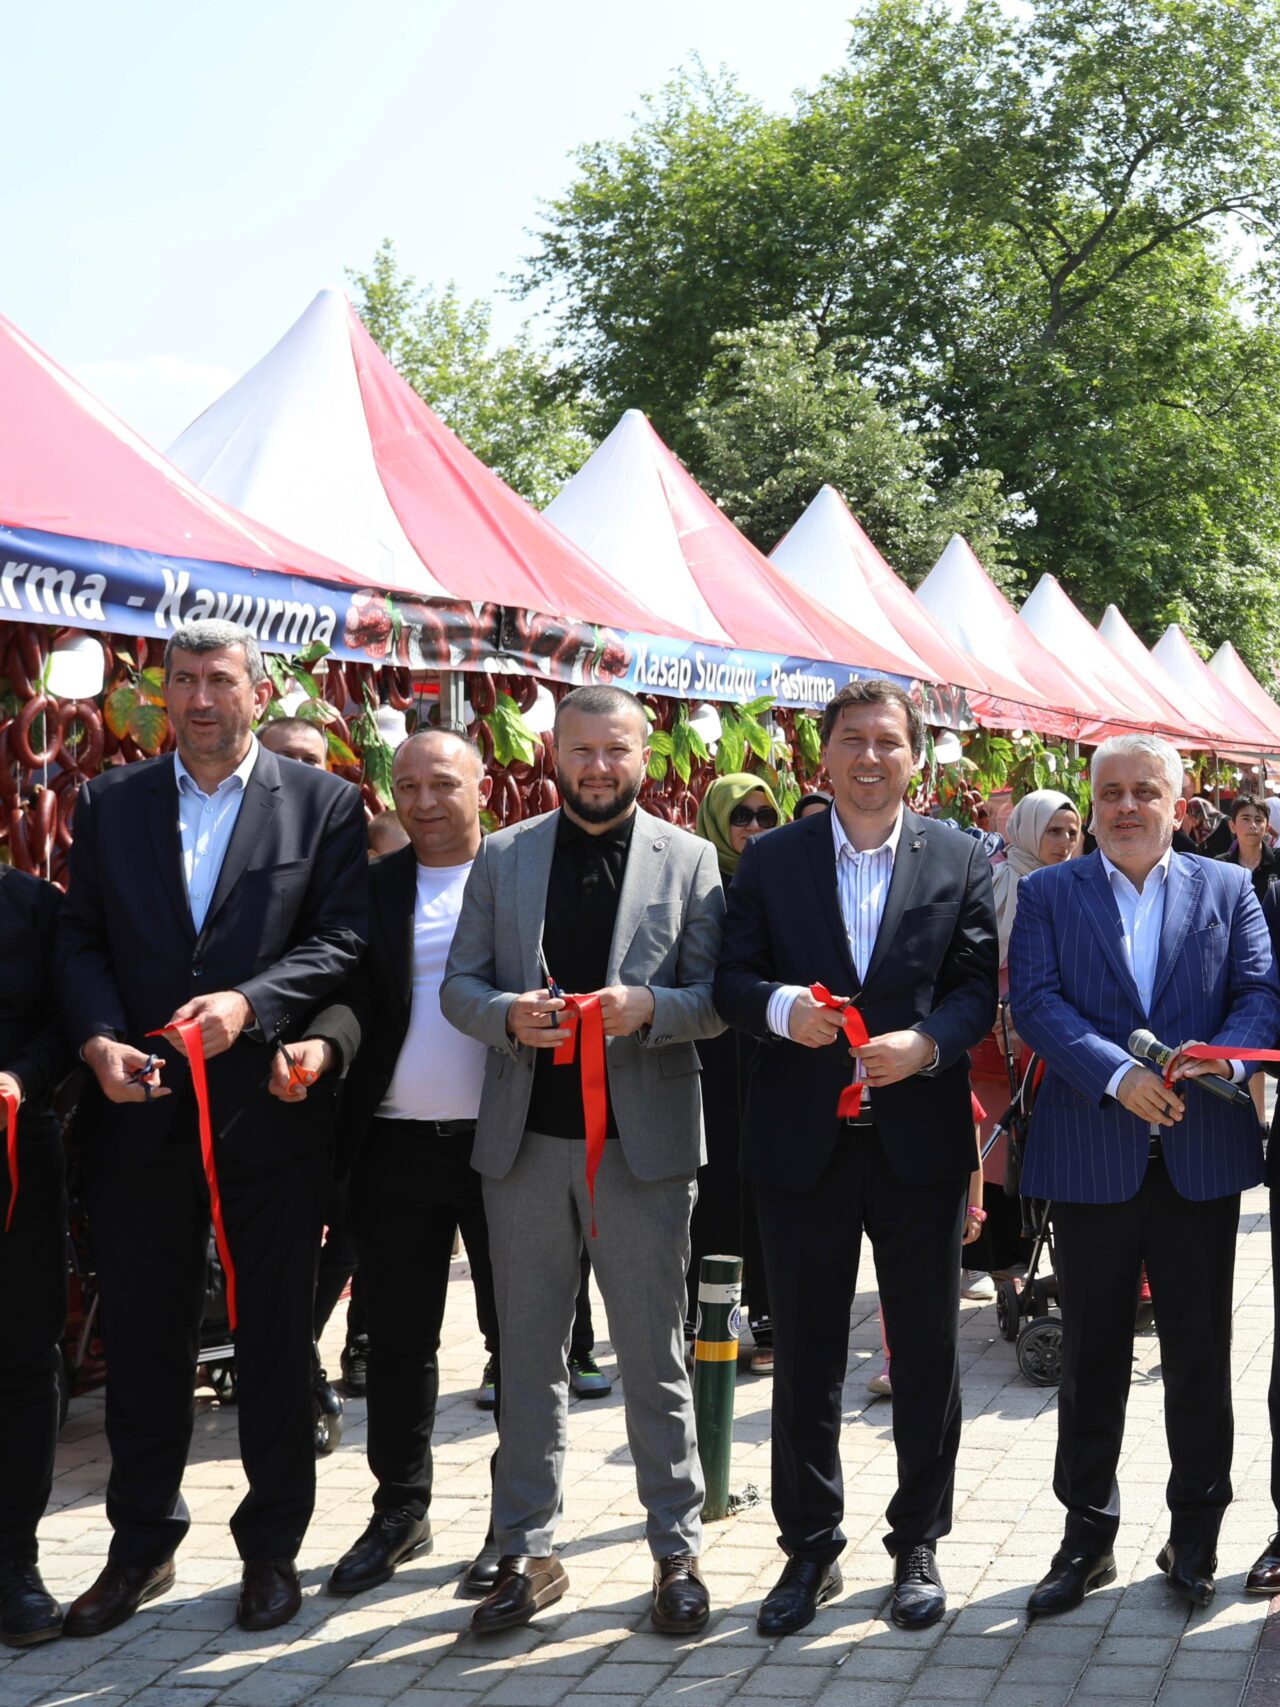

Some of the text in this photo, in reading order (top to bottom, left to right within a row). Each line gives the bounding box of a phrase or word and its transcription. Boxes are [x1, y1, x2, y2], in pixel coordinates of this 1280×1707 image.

[0, 561, 107, 621] rma
[154, 569, 337, 646] Kavurma
[633, 645, 692, 698] Kasap
[771, 661, 836, 703] Pastırma
